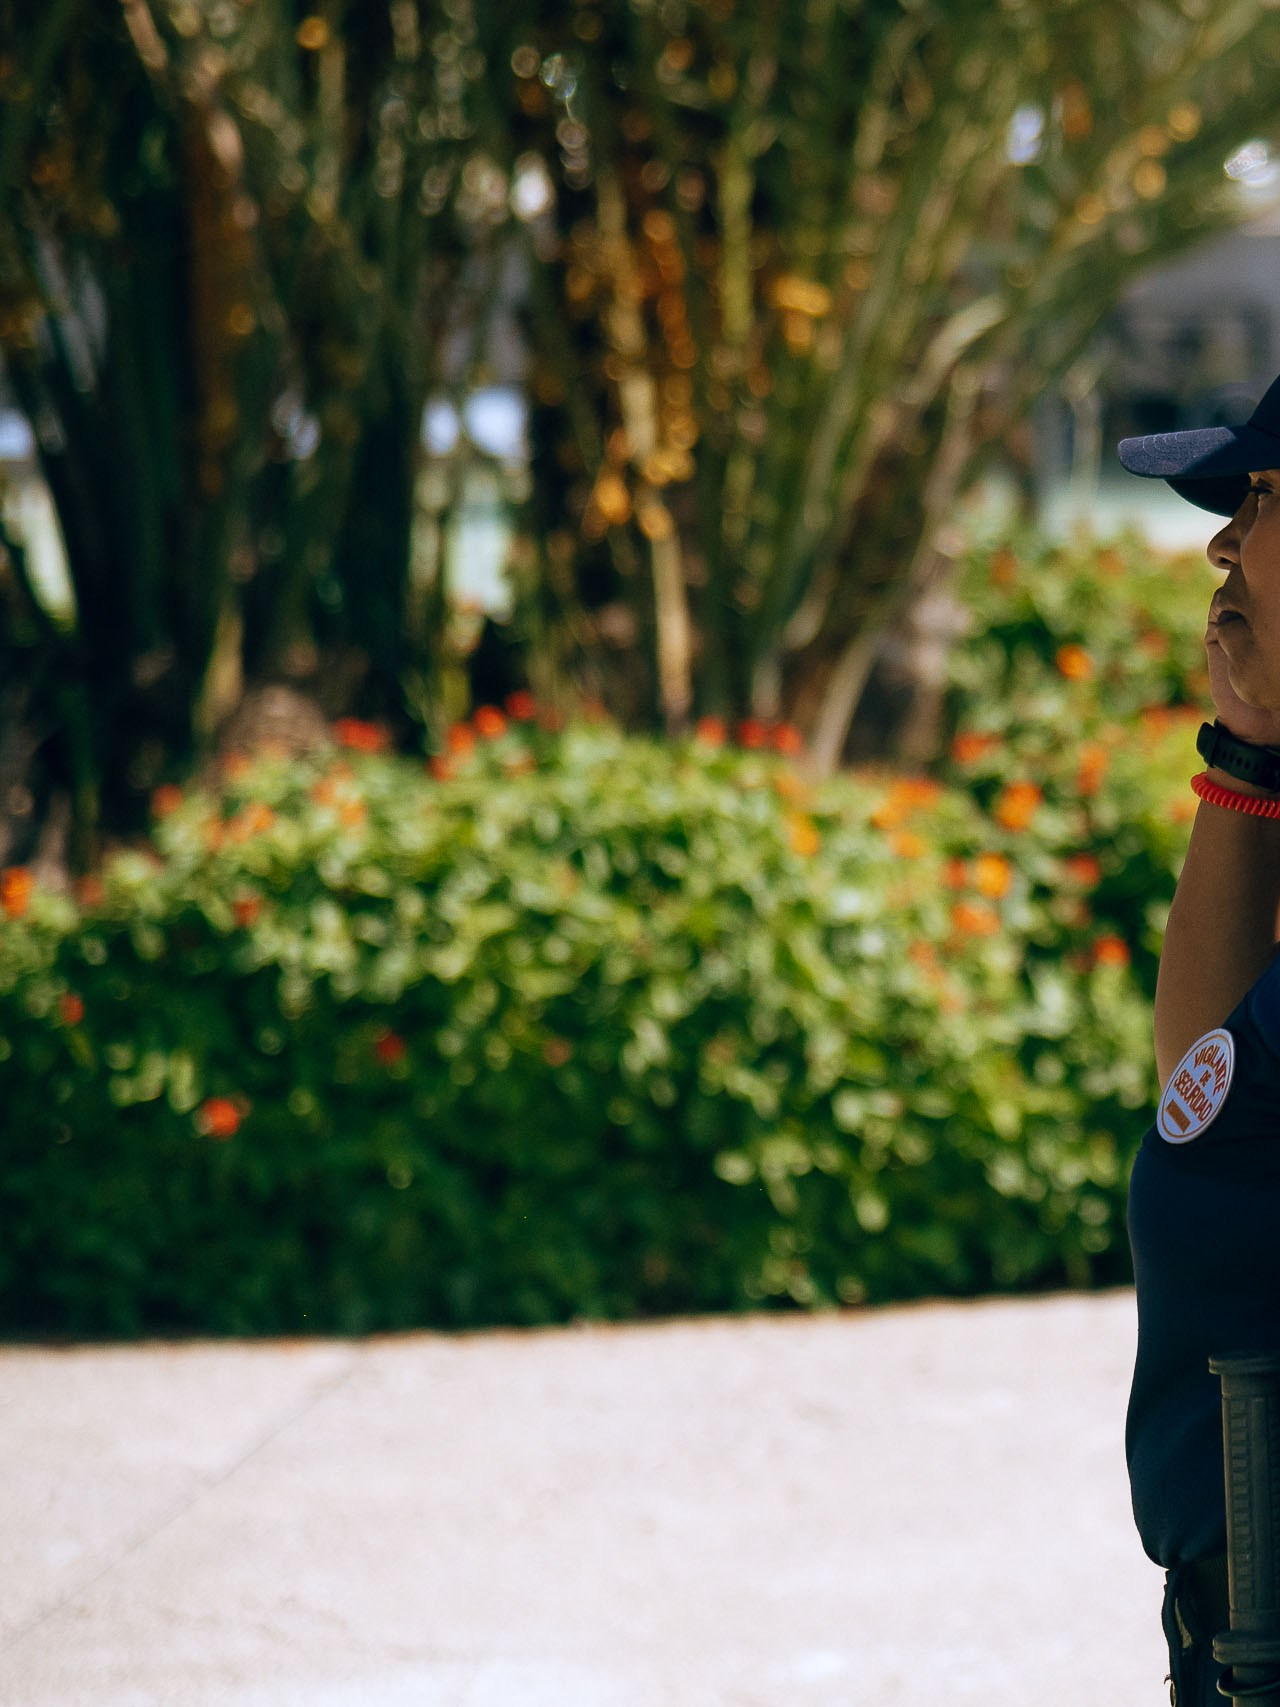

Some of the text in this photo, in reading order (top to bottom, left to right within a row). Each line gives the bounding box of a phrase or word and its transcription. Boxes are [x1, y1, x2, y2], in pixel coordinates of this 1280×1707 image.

[1174, 1069, 1213, 1121] SEGURIDAD
[1193, 1045, 1227, 1096] VIGILANTE
[1199, 1069, 1212, 1087] DE
